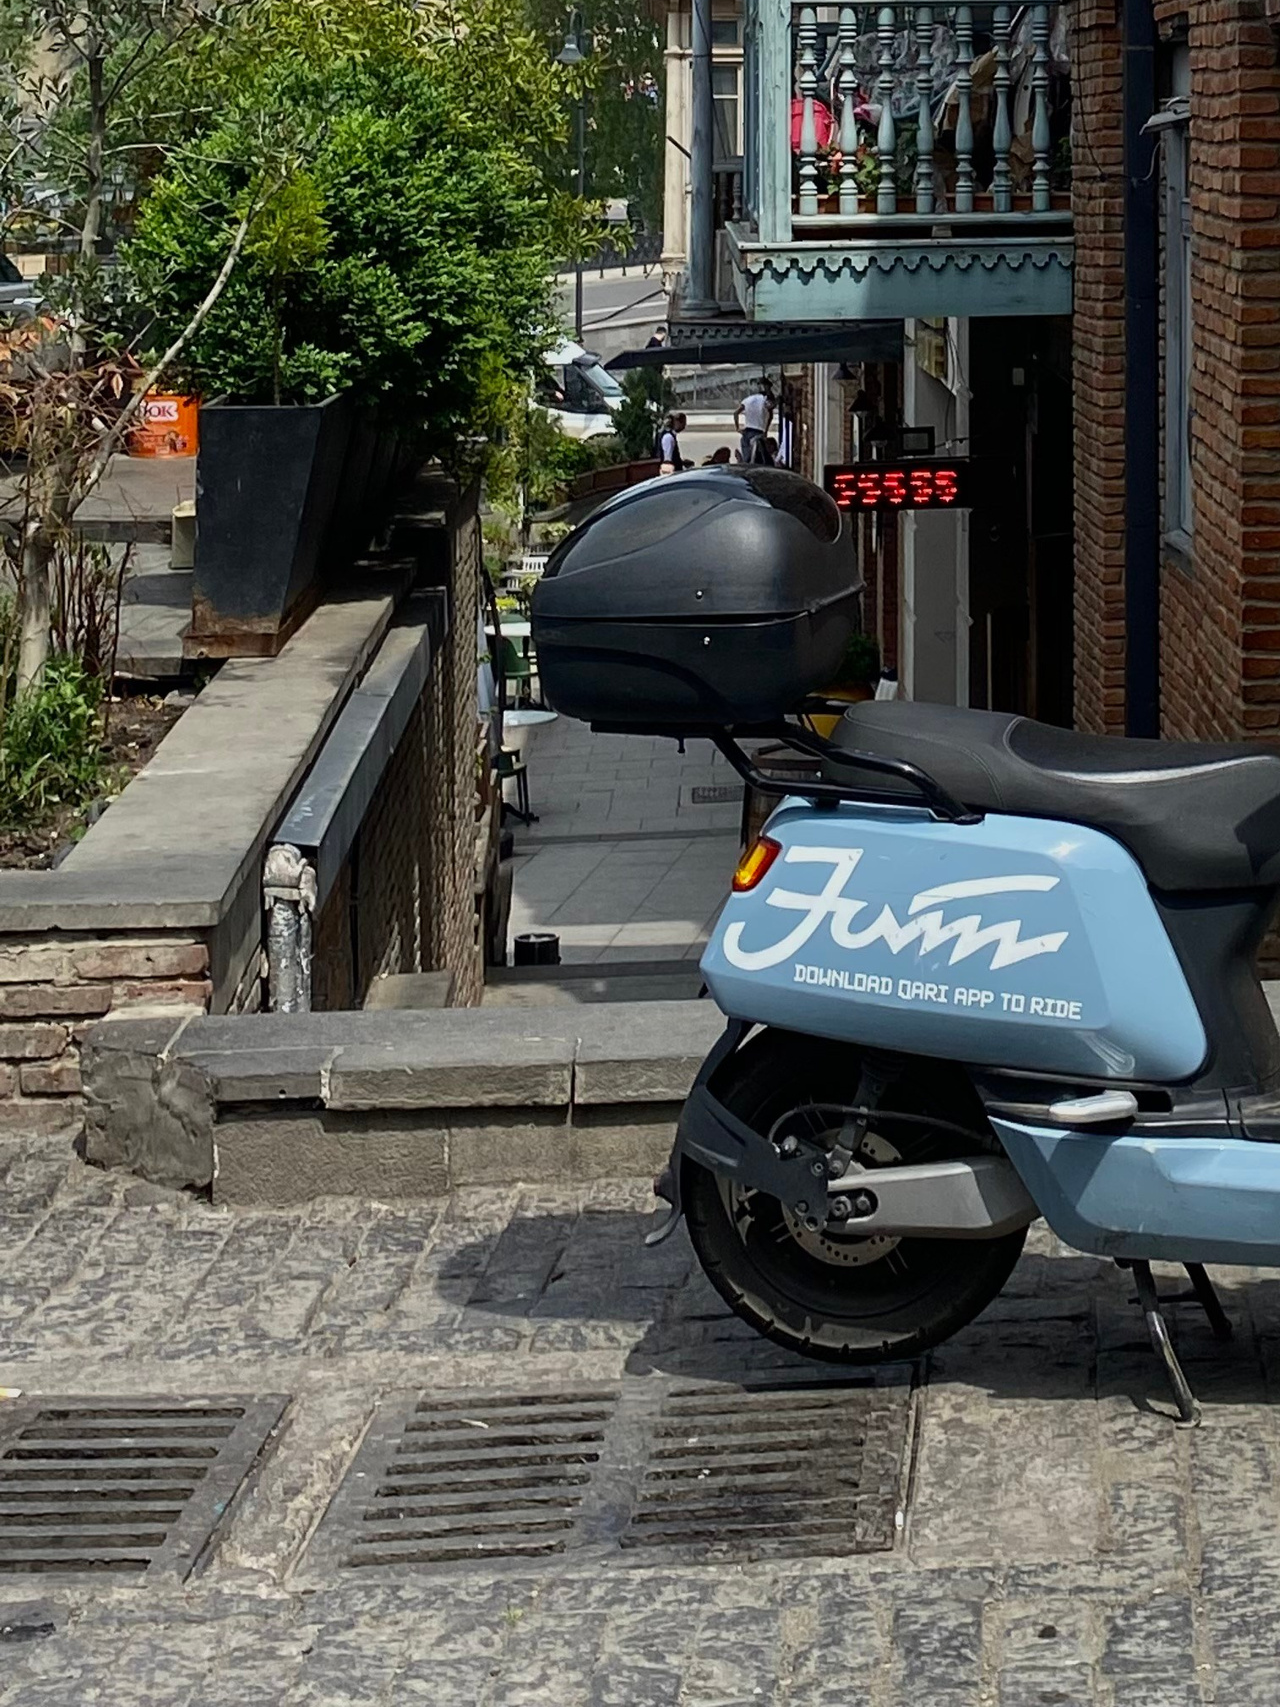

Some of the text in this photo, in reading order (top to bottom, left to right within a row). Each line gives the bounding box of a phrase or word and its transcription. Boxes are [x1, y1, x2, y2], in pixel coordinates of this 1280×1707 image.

[794, 963, 1083, 1020] DOWNLOAD QARI APP TO RIDE
